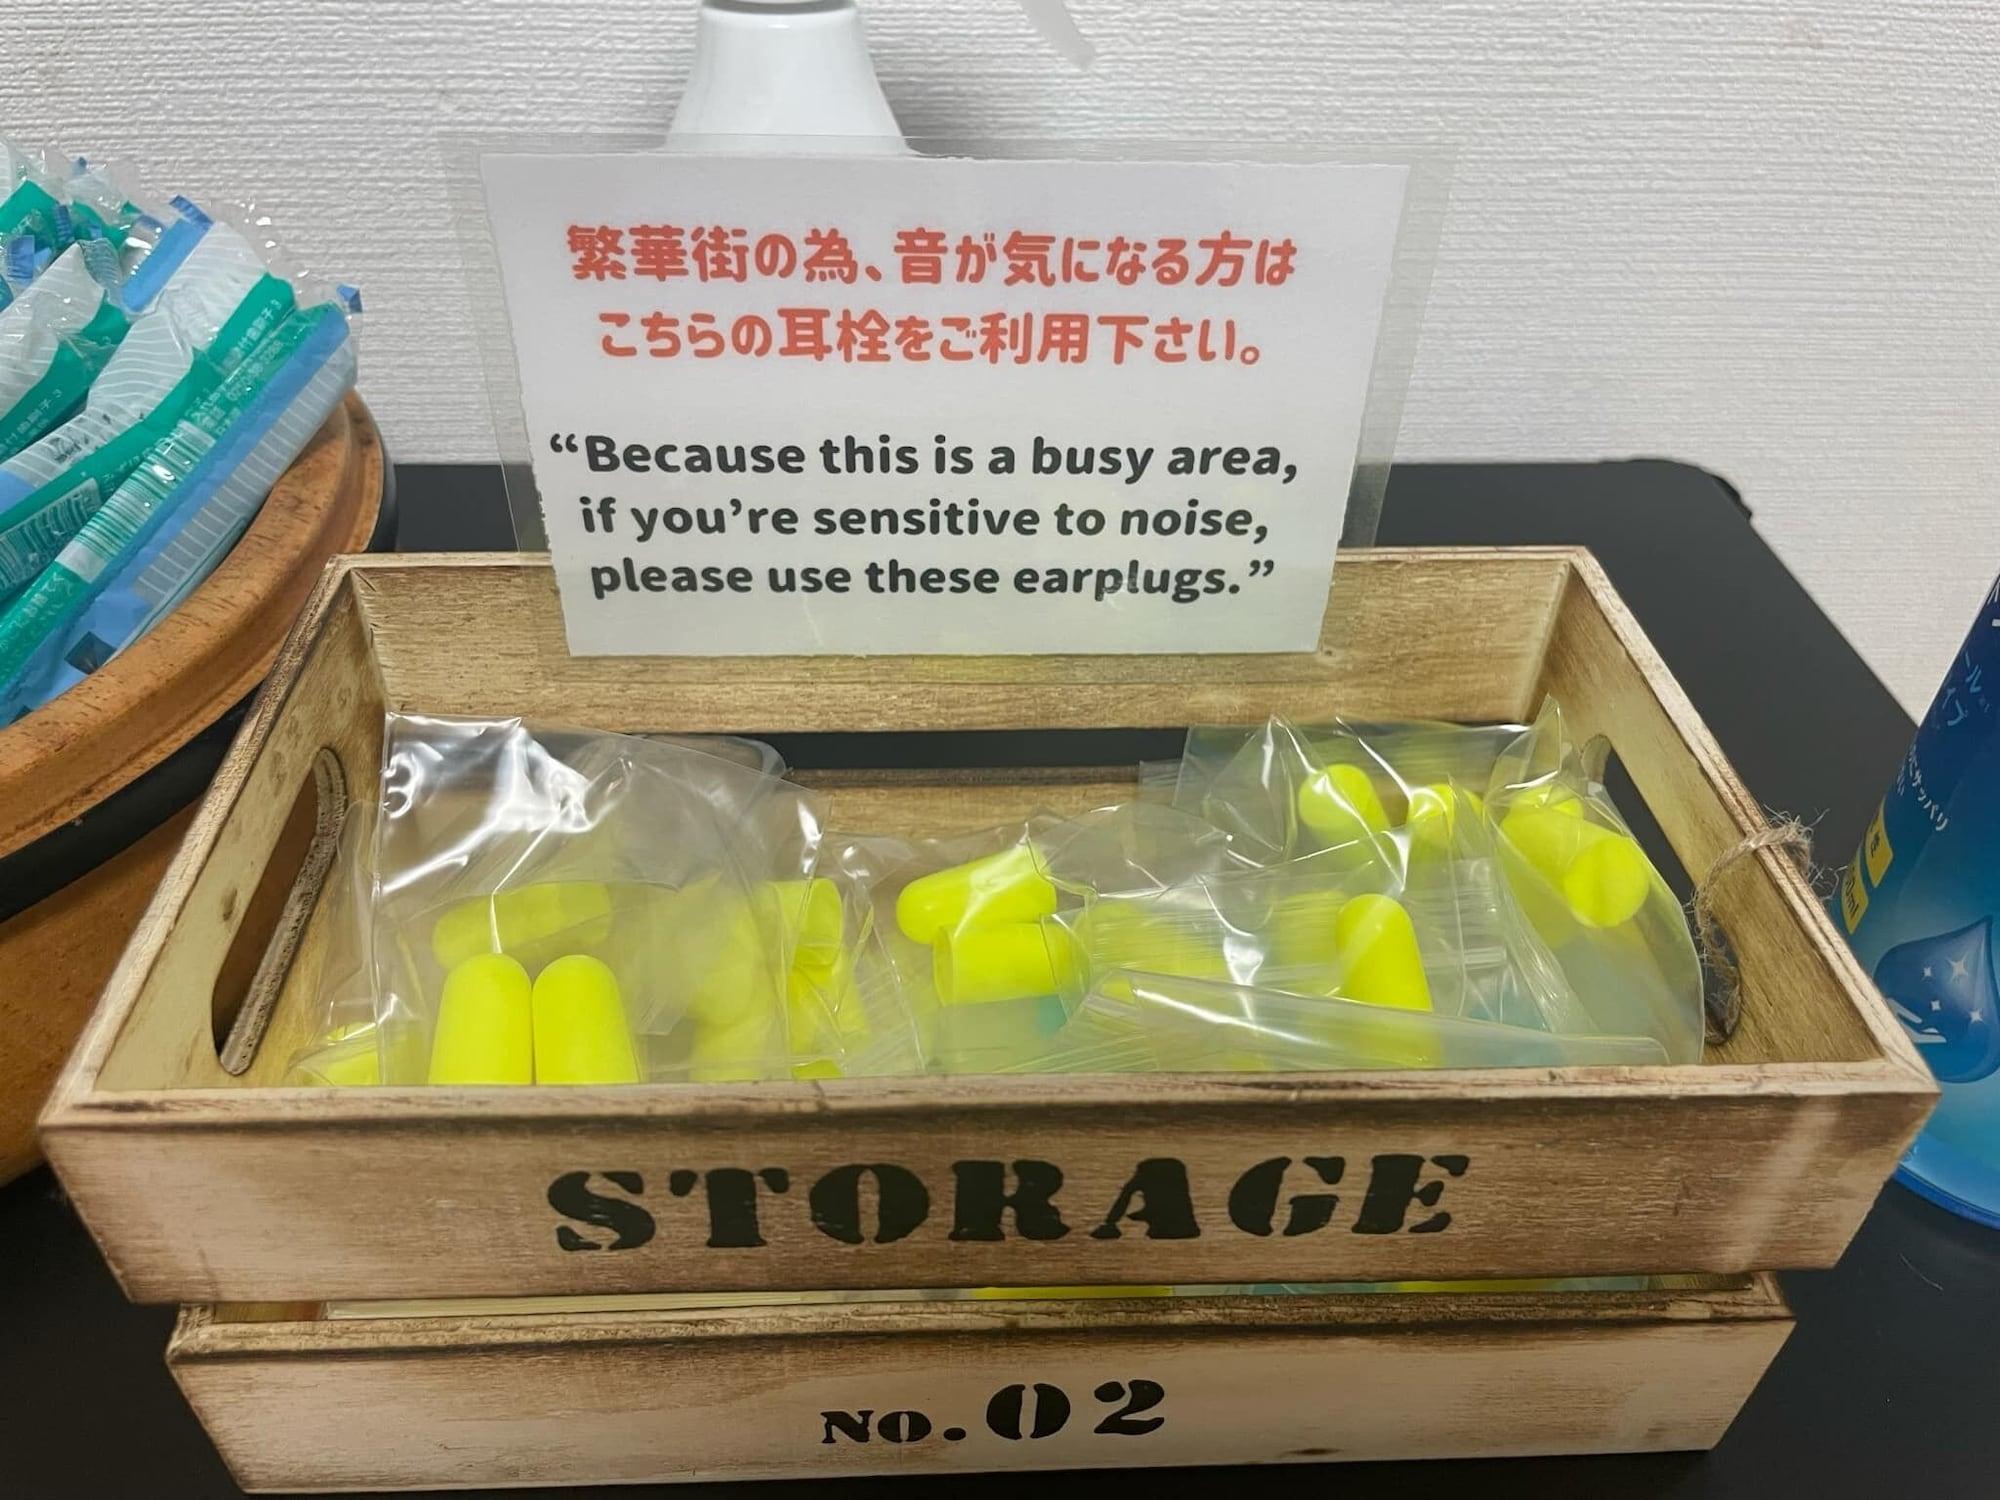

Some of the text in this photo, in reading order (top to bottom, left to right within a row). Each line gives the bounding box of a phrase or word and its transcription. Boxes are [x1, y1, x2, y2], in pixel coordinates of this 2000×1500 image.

[567, 224, 1297, 287] 繁華街の為、音が気になる方は
[599, 308, 1263, 365] こちらの耳栓をご利用下さい。
[818, 434, 919, 475] this
[934, 434, 974, 475] is
[988, 446, 1015, 475] a
[1032, 435, 1155, 485] busy
[1167, 446, 1297, 485] area,
[579, 495, 1268, 544] if you’re sensitive to noise,
[590, 556, 753, 601] please
[768, 567, 852, 594] use
[864, 558, 1000, 594] these
[547, 1153, 1471, 1253] STORAGE
